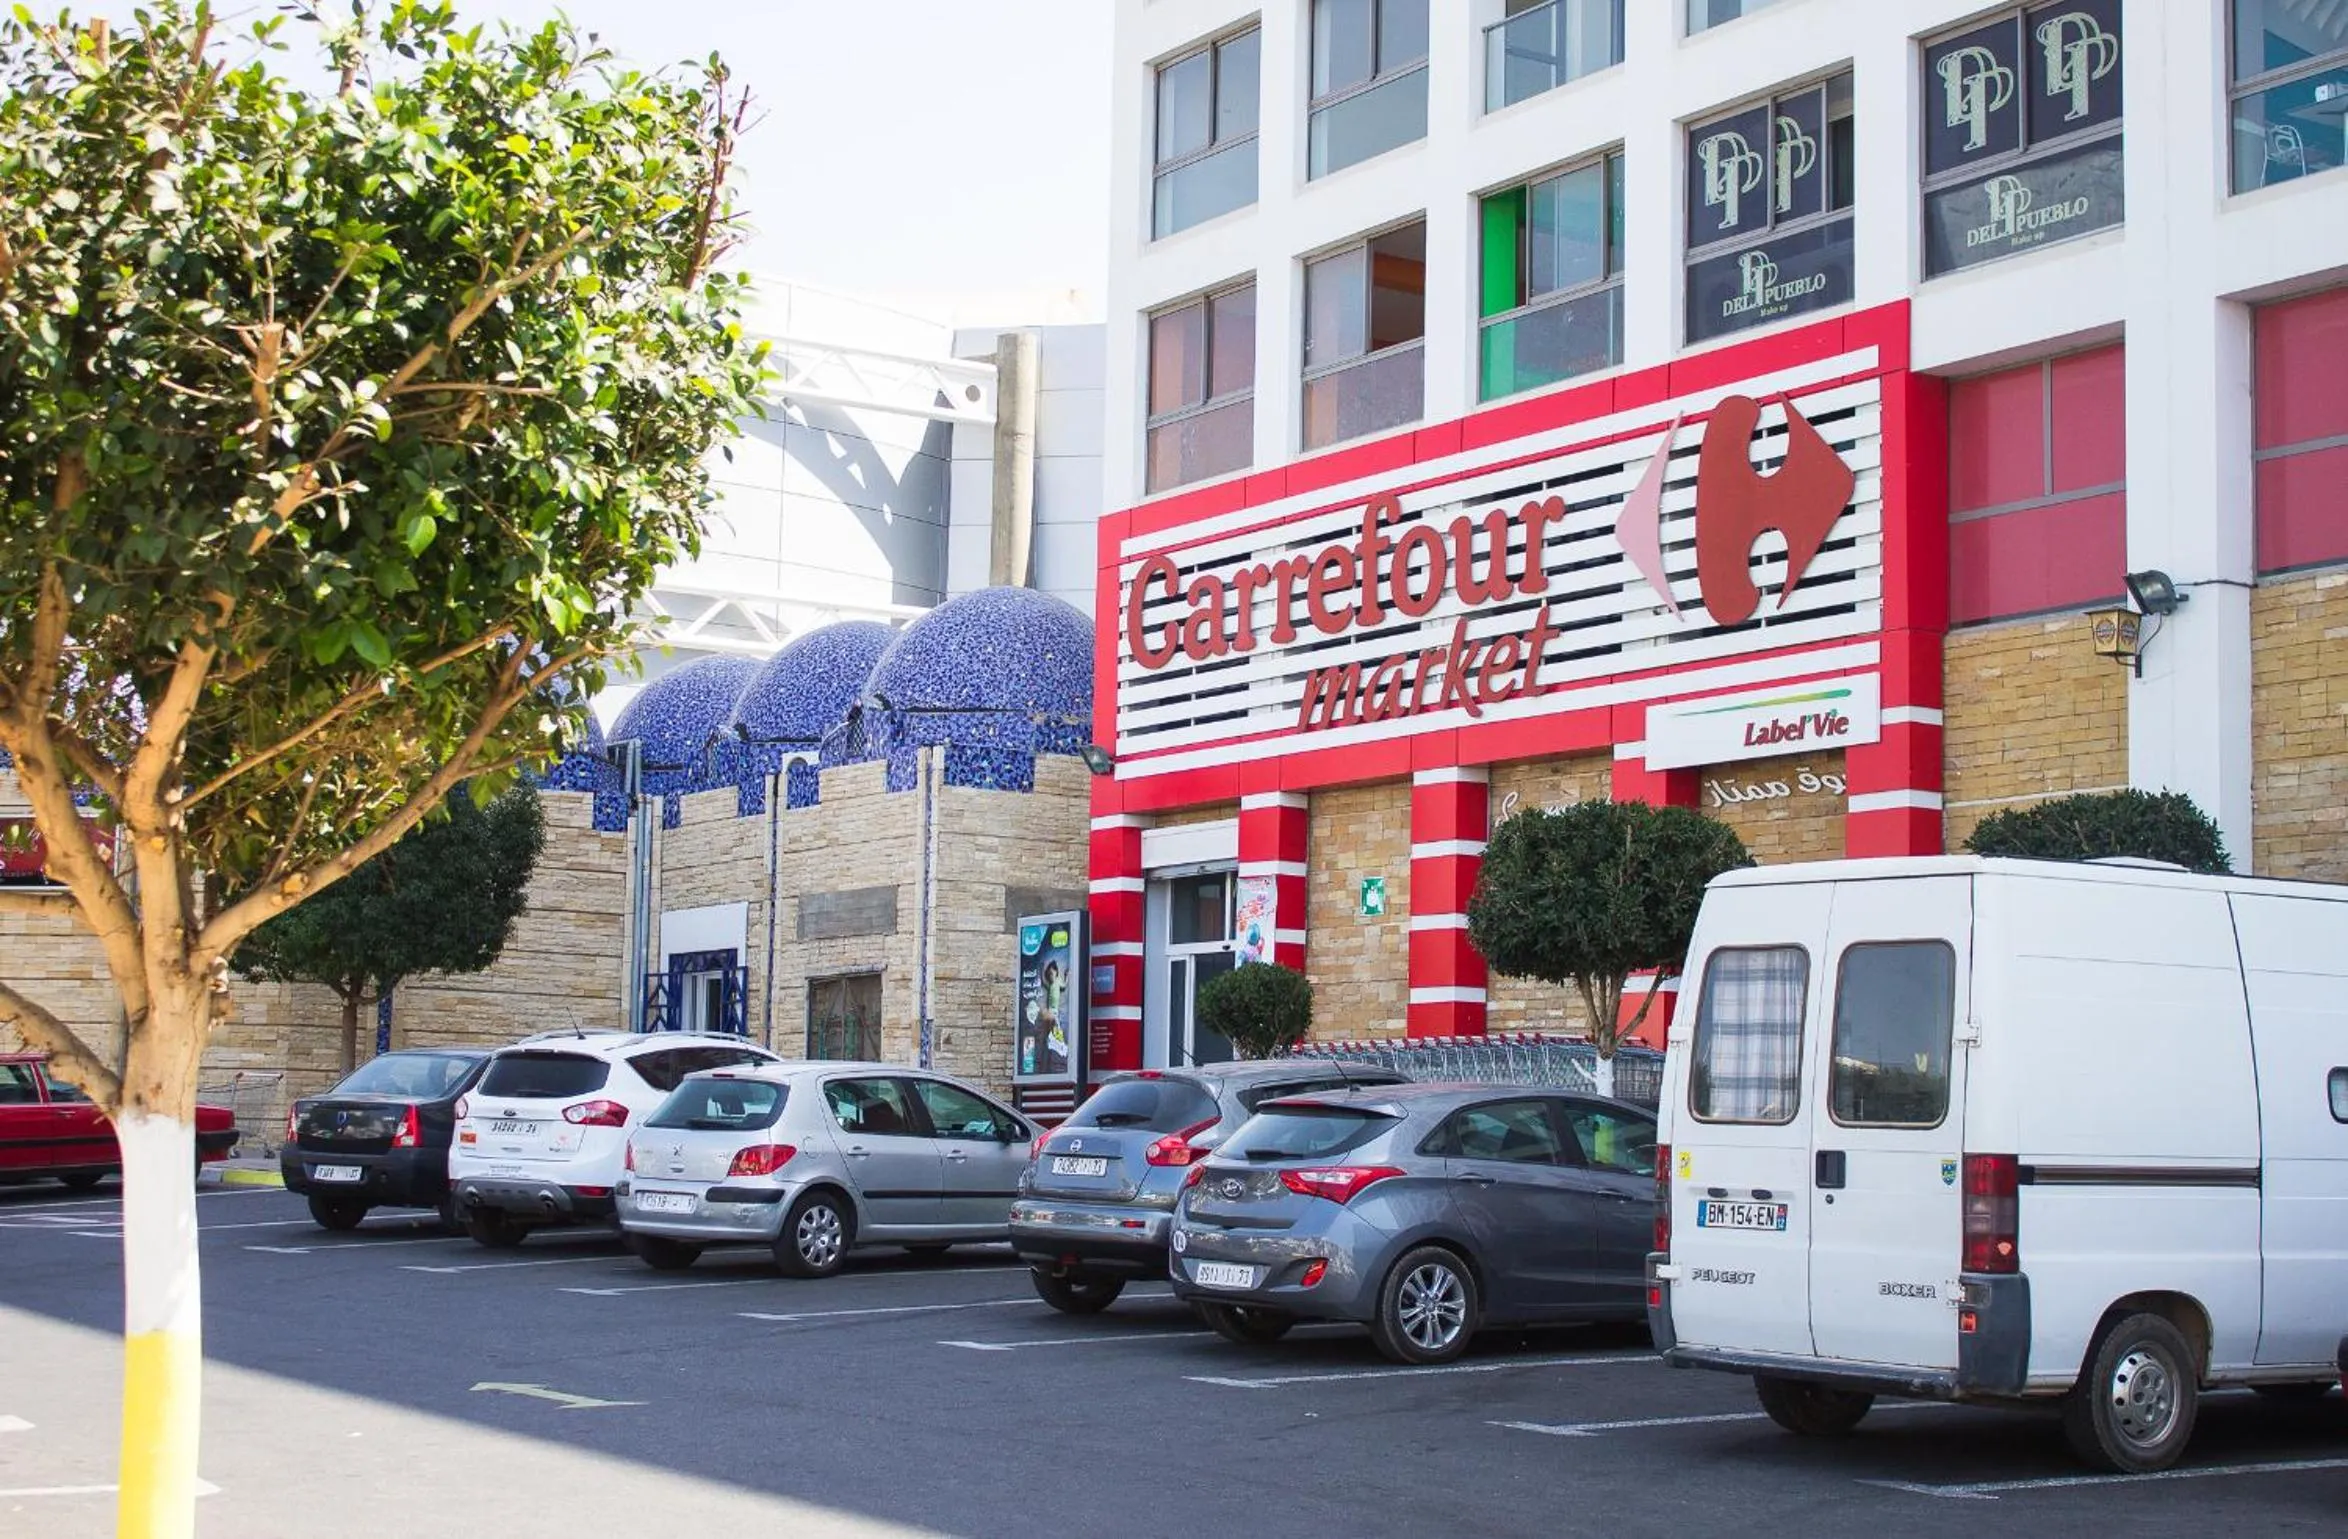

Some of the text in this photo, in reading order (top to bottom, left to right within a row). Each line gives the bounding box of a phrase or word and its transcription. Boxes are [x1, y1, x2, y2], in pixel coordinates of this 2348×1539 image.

[1967, 197, 2089, 248] DEL PUEBLO
[1722, 273, 1826, 318] DEL PUEBLO
[1127, 494, 1567, 670] Carrefour
[1298, 605, 1561, 733] market
[1691, 1267, 1756, 1285] PEUGEOT
[1878, 1281, 1937, 1299] BOXER
